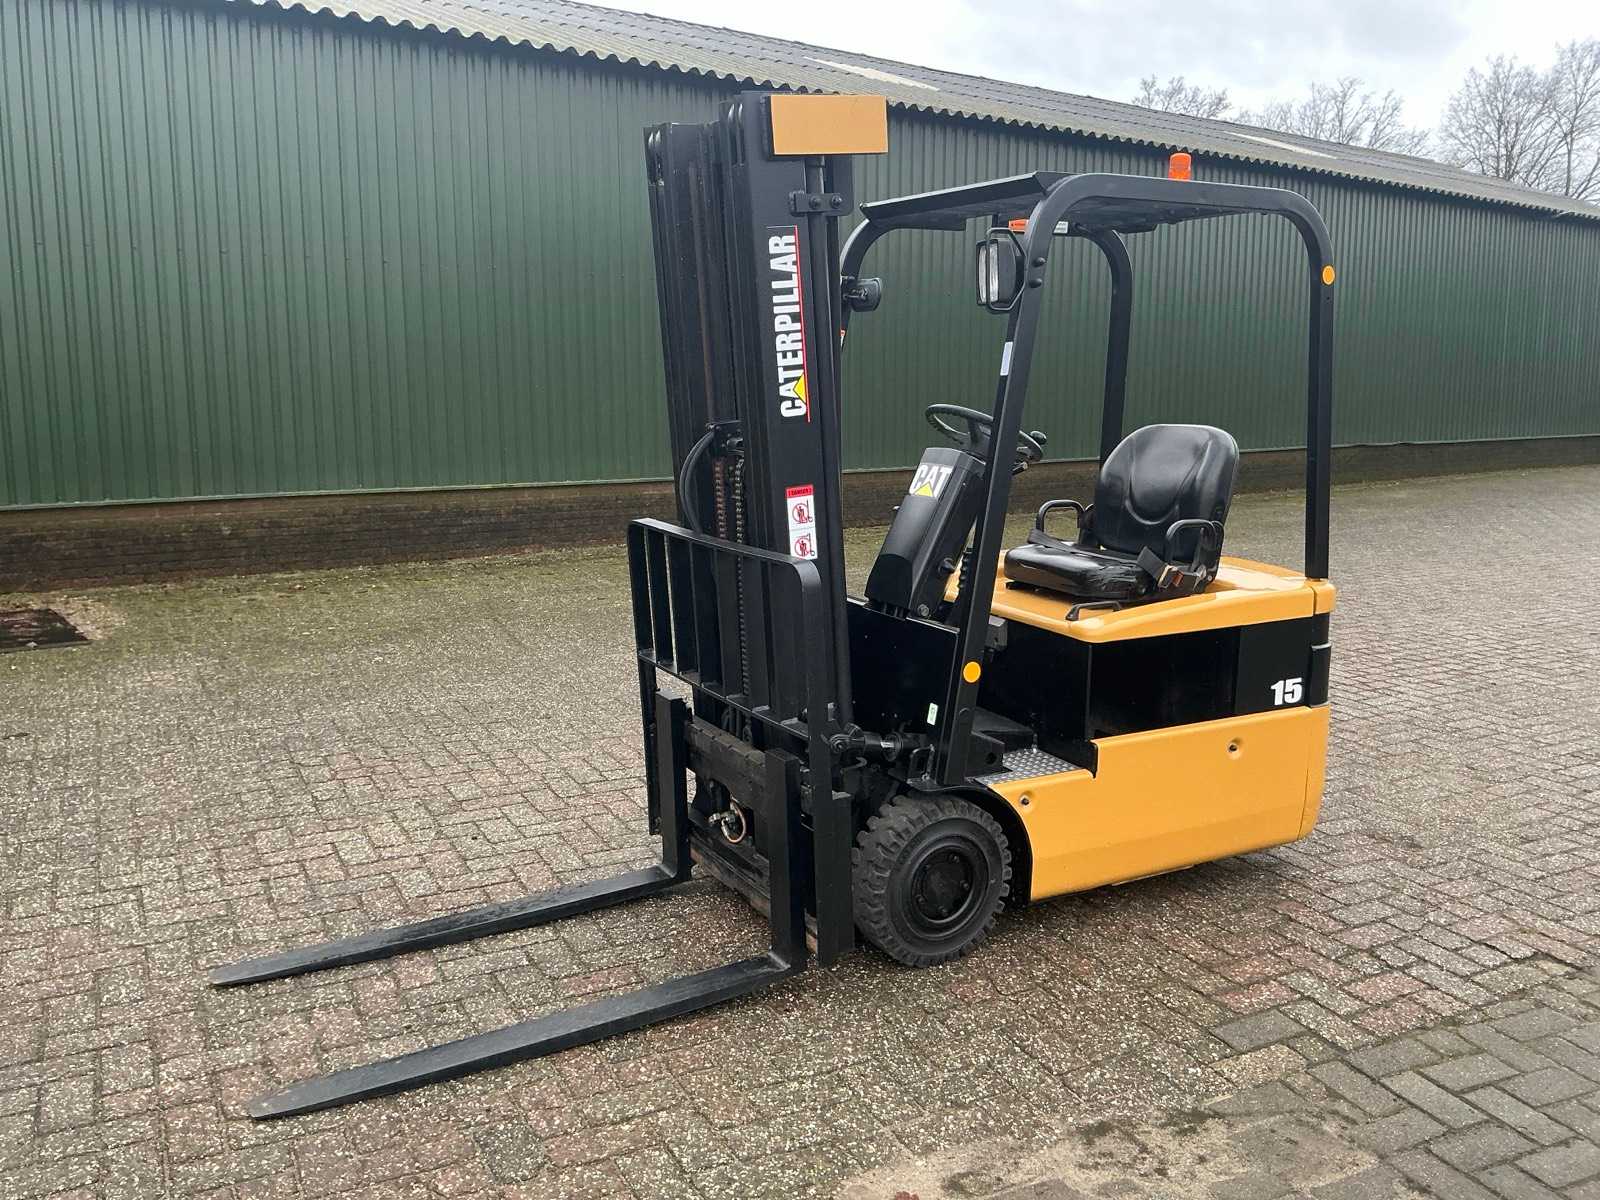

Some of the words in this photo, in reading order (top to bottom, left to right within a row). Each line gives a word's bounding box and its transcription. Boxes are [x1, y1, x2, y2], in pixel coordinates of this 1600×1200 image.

[768, 235, 807, 418] CATERPILLAR
[909, 464, 953, 498] CAT
[1270, 677, 1302, 706] 15
